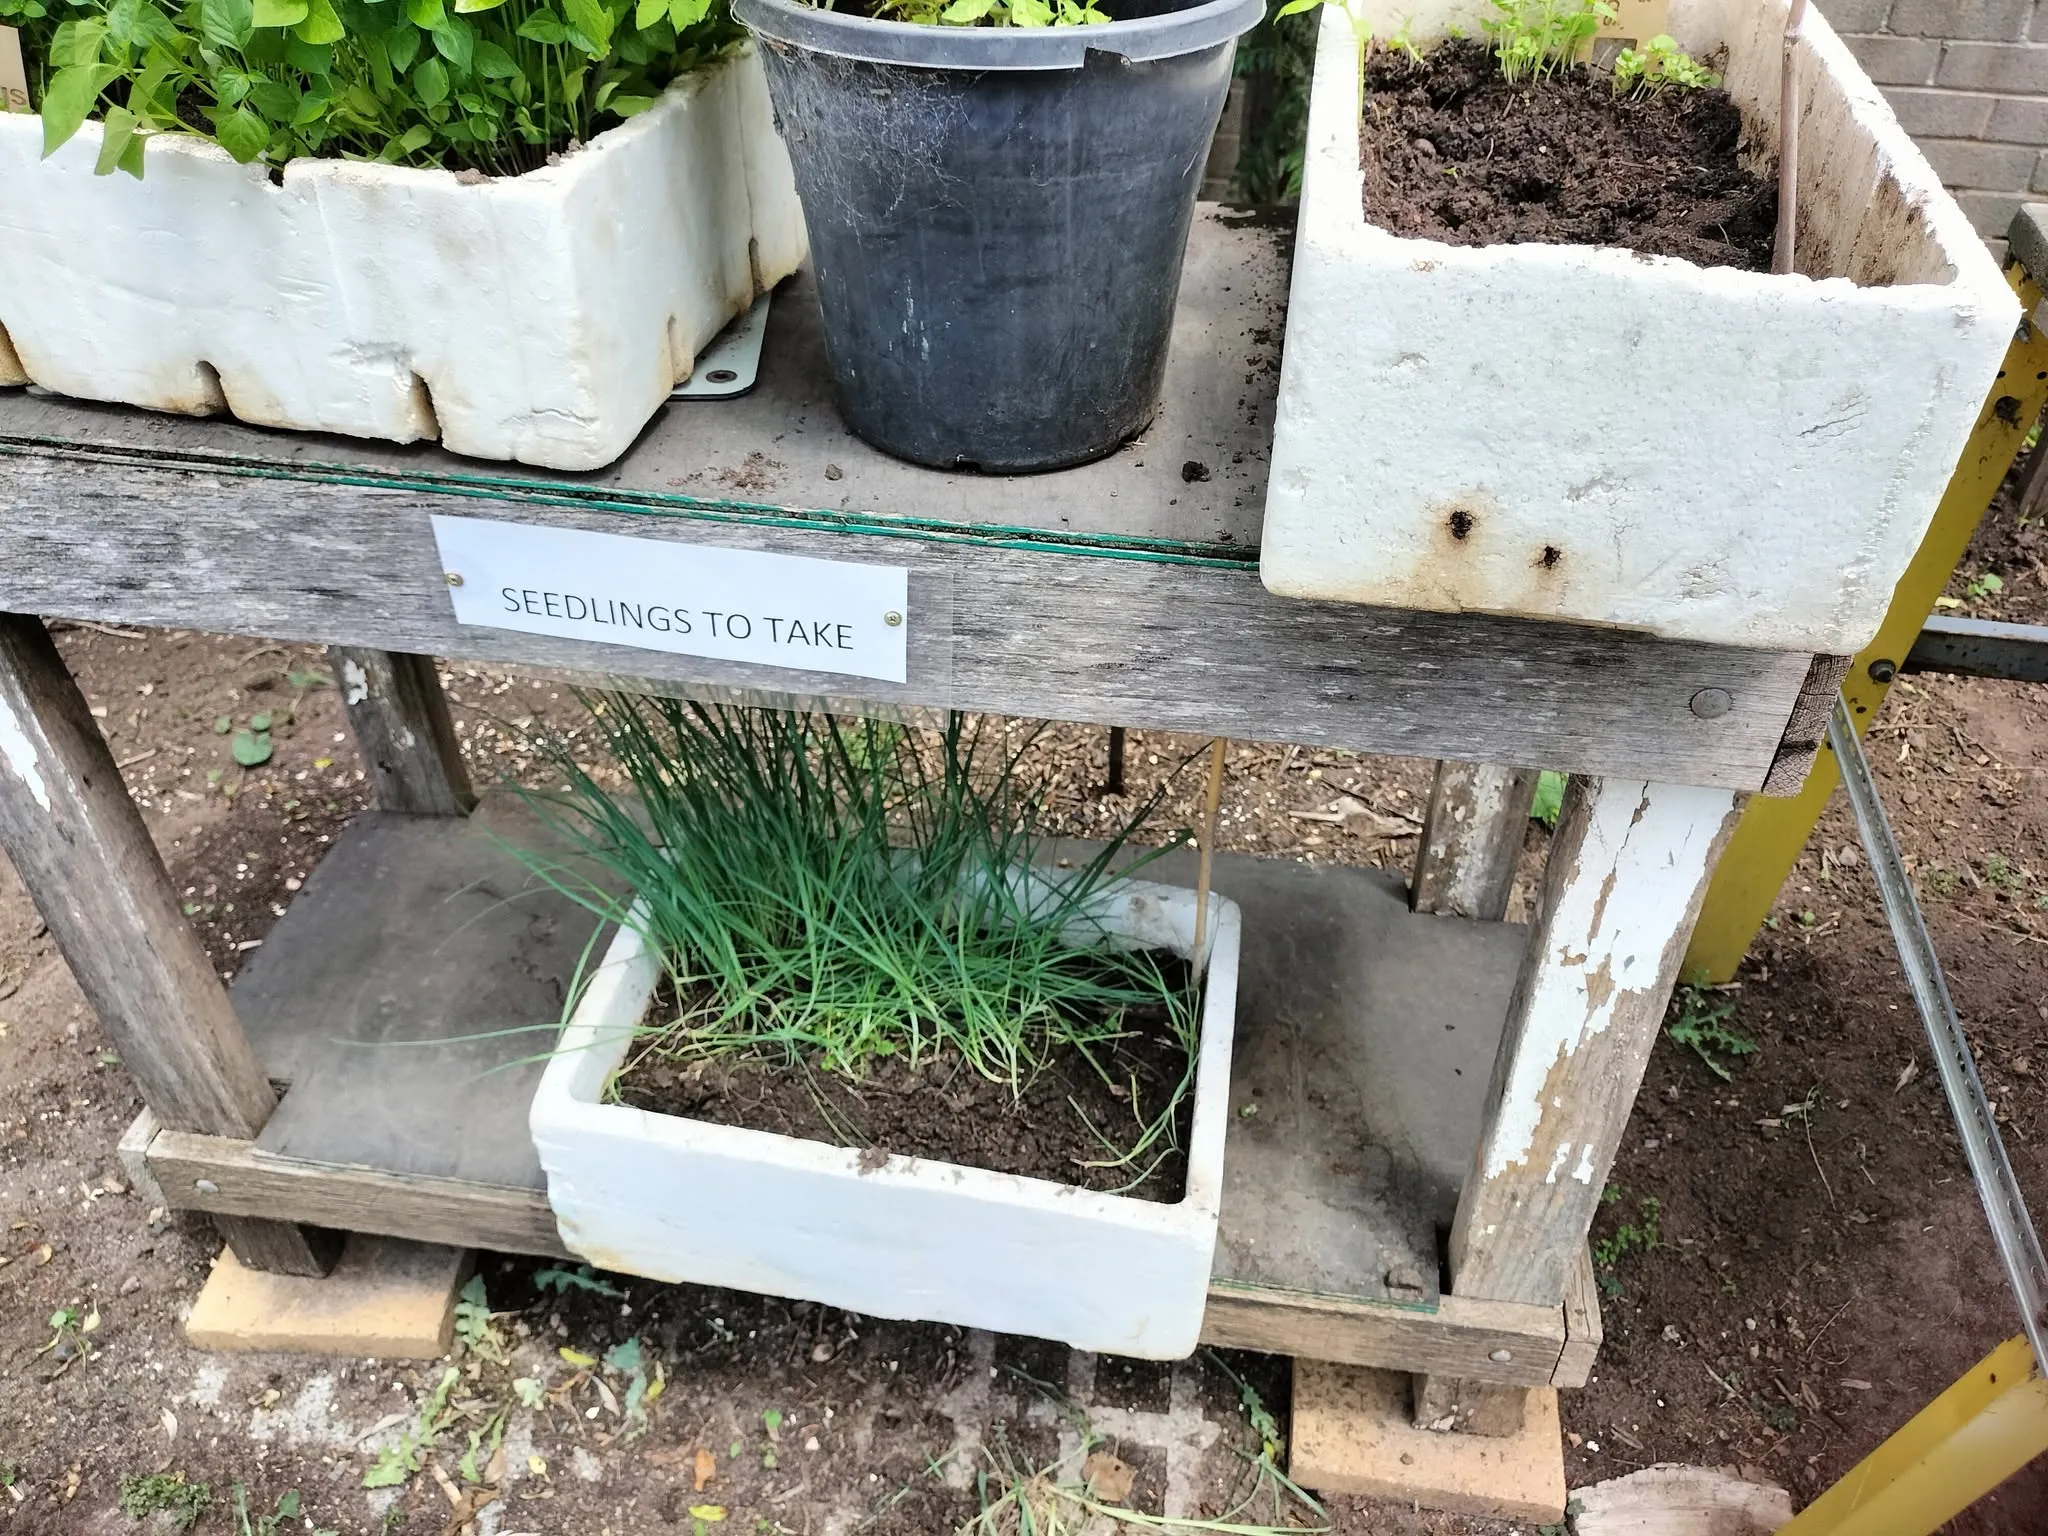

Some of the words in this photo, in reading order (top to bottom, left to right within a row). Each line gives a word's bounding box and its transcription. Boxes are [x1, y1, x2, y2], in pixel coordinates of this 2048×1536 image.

[502, 587, 692, 634] SEEDLINGS
[701, 611, 752, 639] TO
[762, 617, 854, 650] TAKE
